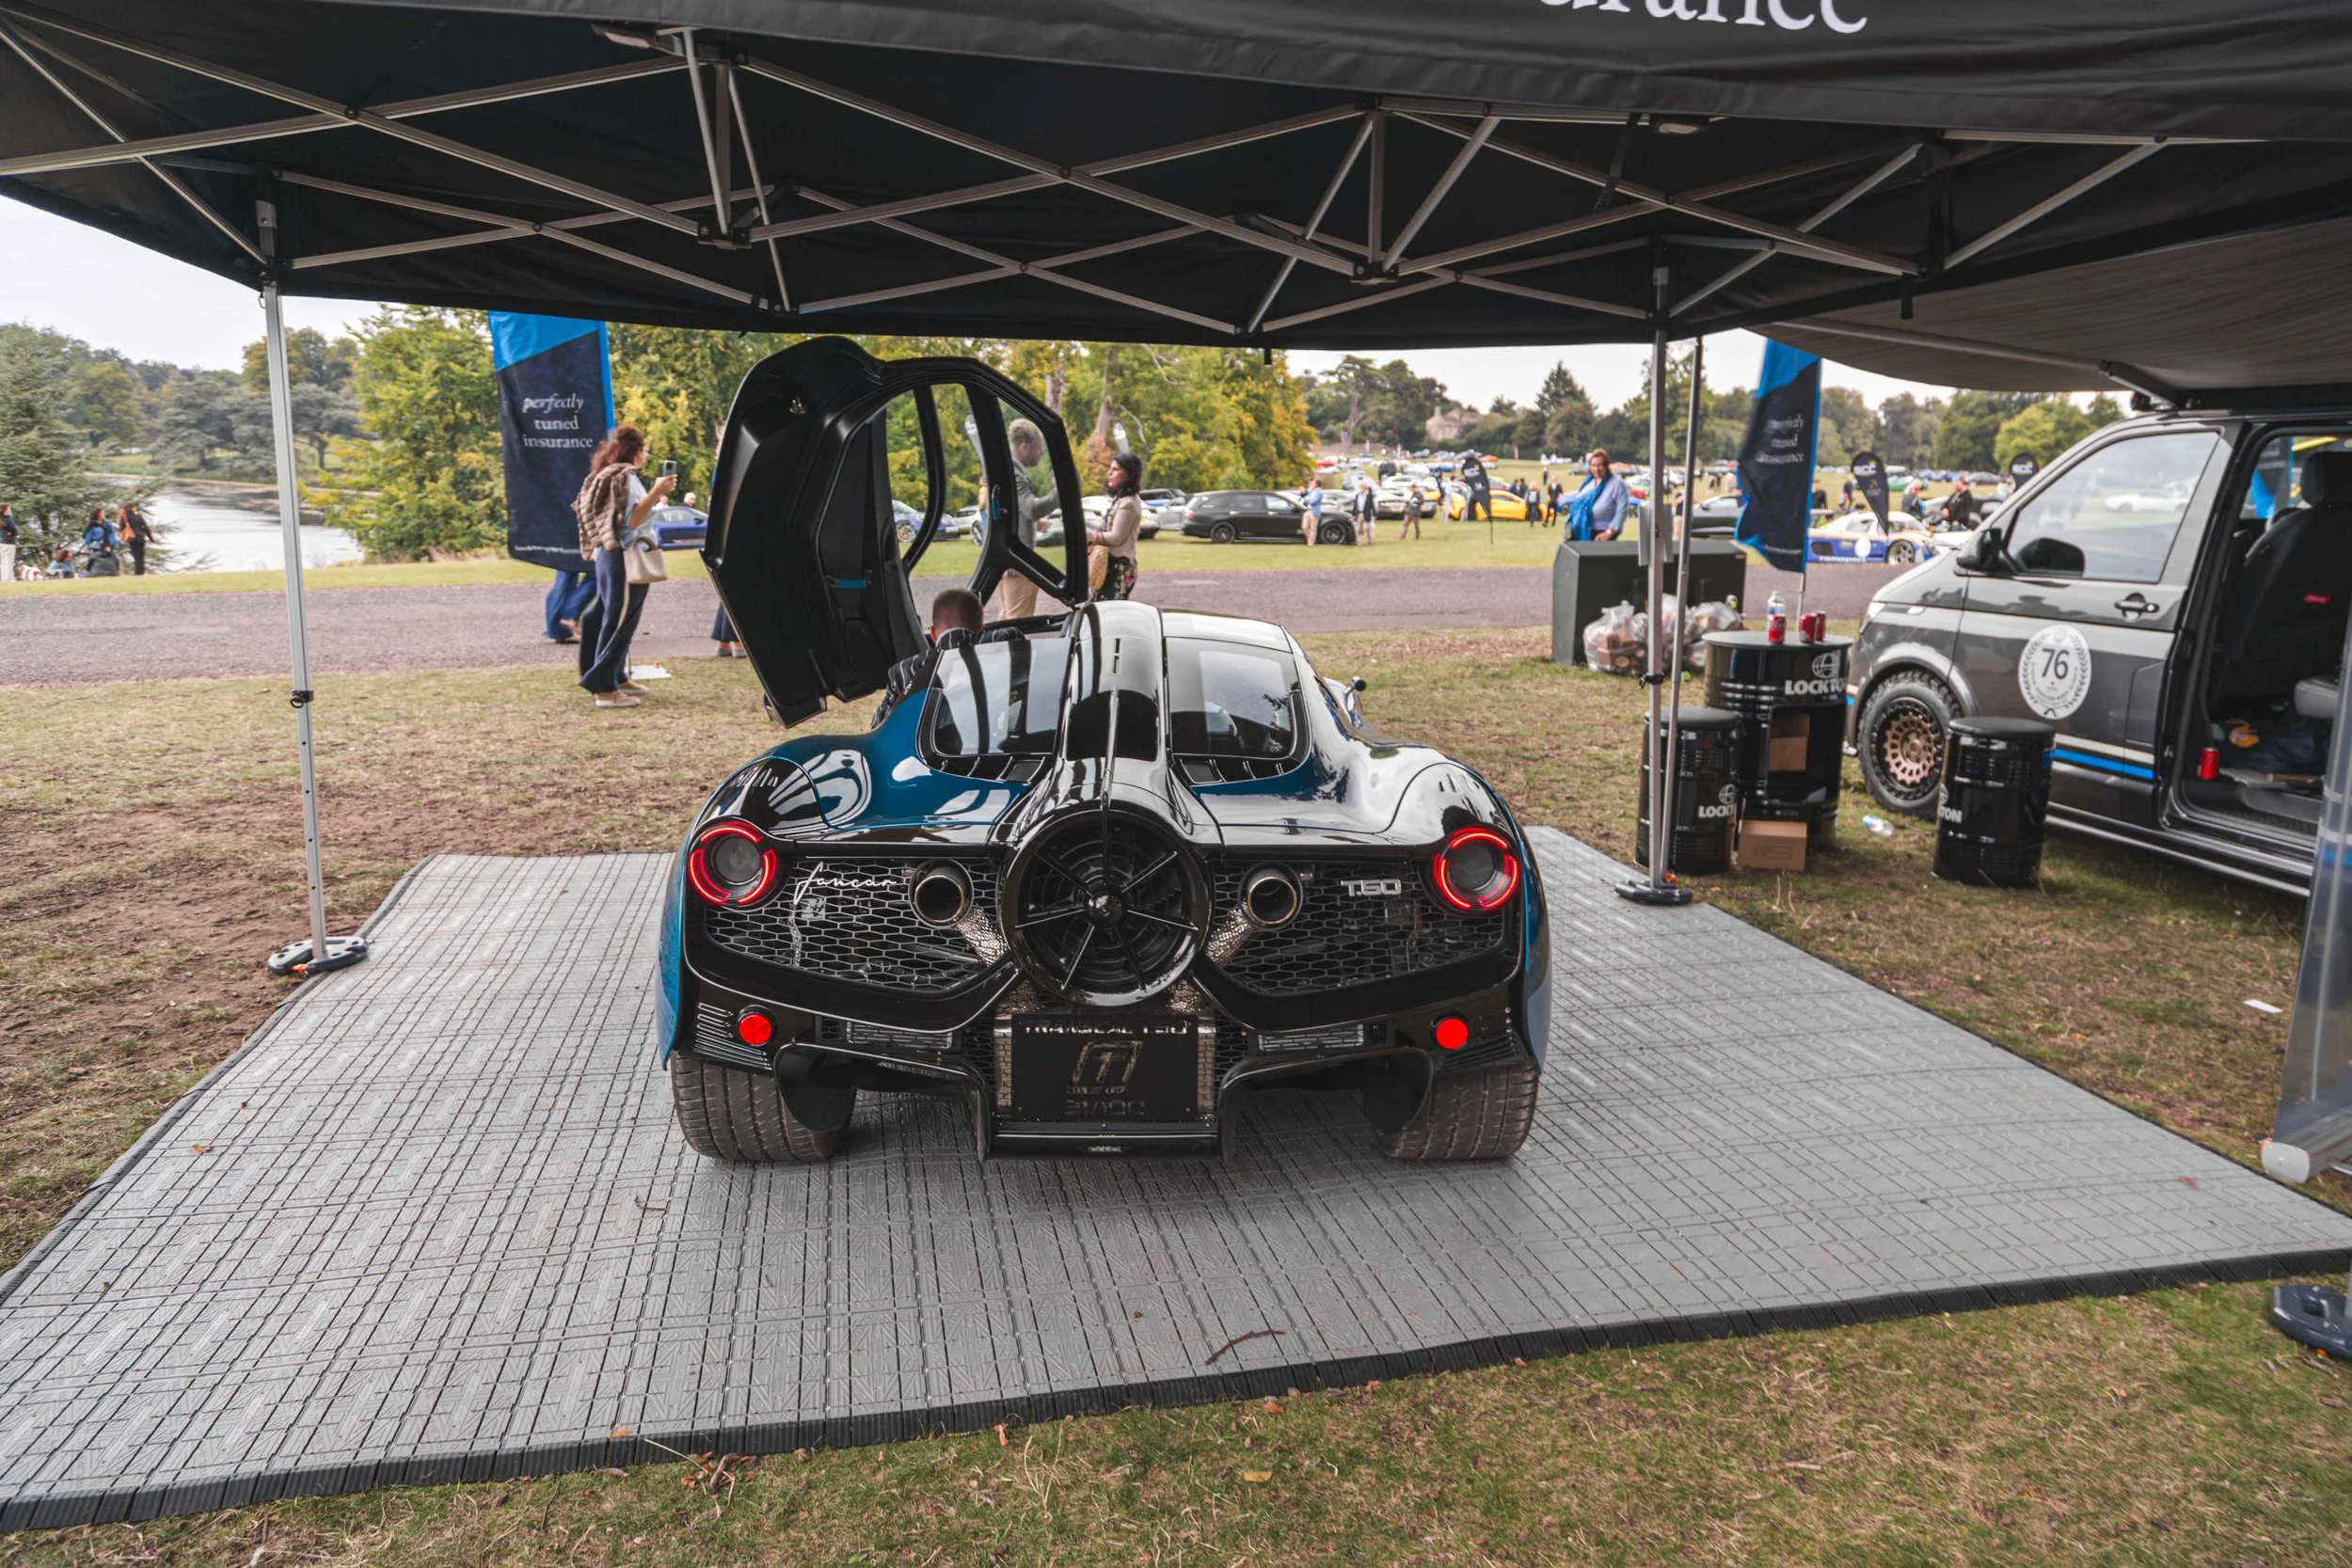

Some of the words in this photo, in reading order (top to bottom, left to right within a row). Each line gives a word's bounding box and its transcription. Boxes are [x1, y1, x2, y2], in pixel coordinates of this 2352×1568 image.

[522, 393, 584, 414] perfectly
[533, 415, 580, 430] tuned
[522, 434, 595, 449] insurance
[2042, 647, 2070, 680] 76
[1341, 879, 1402, 897] T.50
